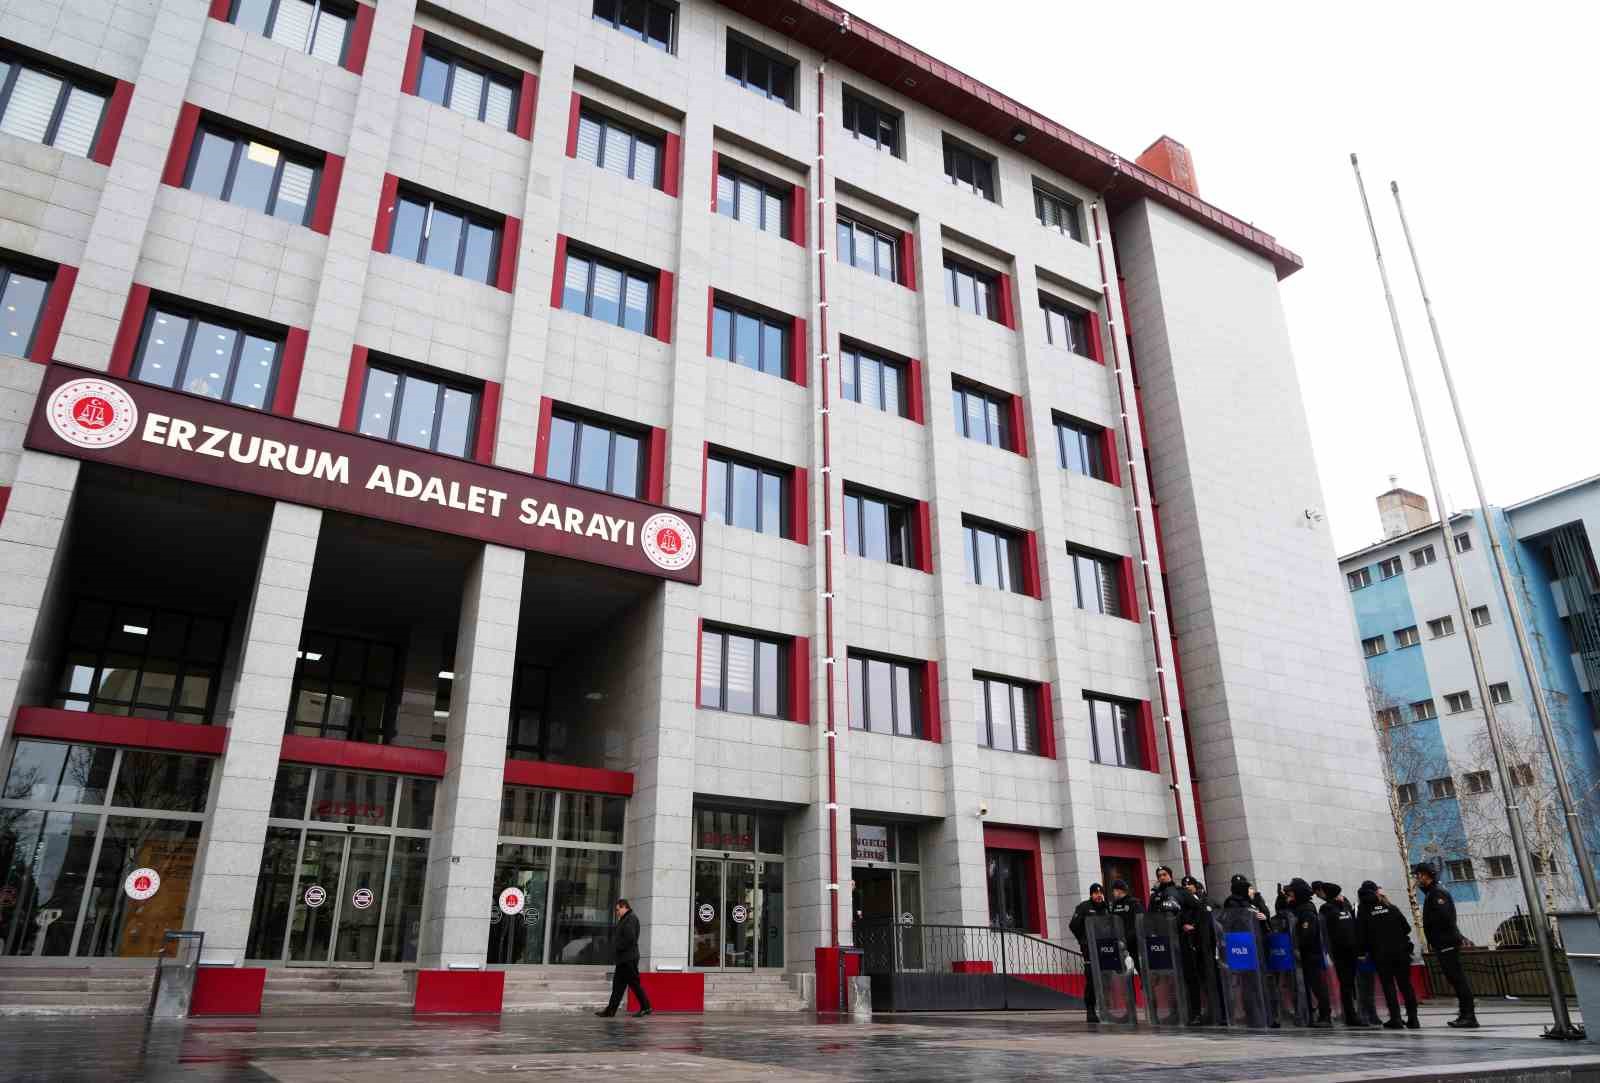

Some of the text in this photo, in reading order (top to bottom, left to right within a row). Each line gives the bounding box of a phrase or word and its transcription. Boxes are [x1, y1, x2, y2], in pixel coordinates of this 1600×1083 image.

[142, 412, 349, 485] ERZURUM
[365, 464, 507, 517] ADALET
[518, 497, 634, 546] SARAYI
